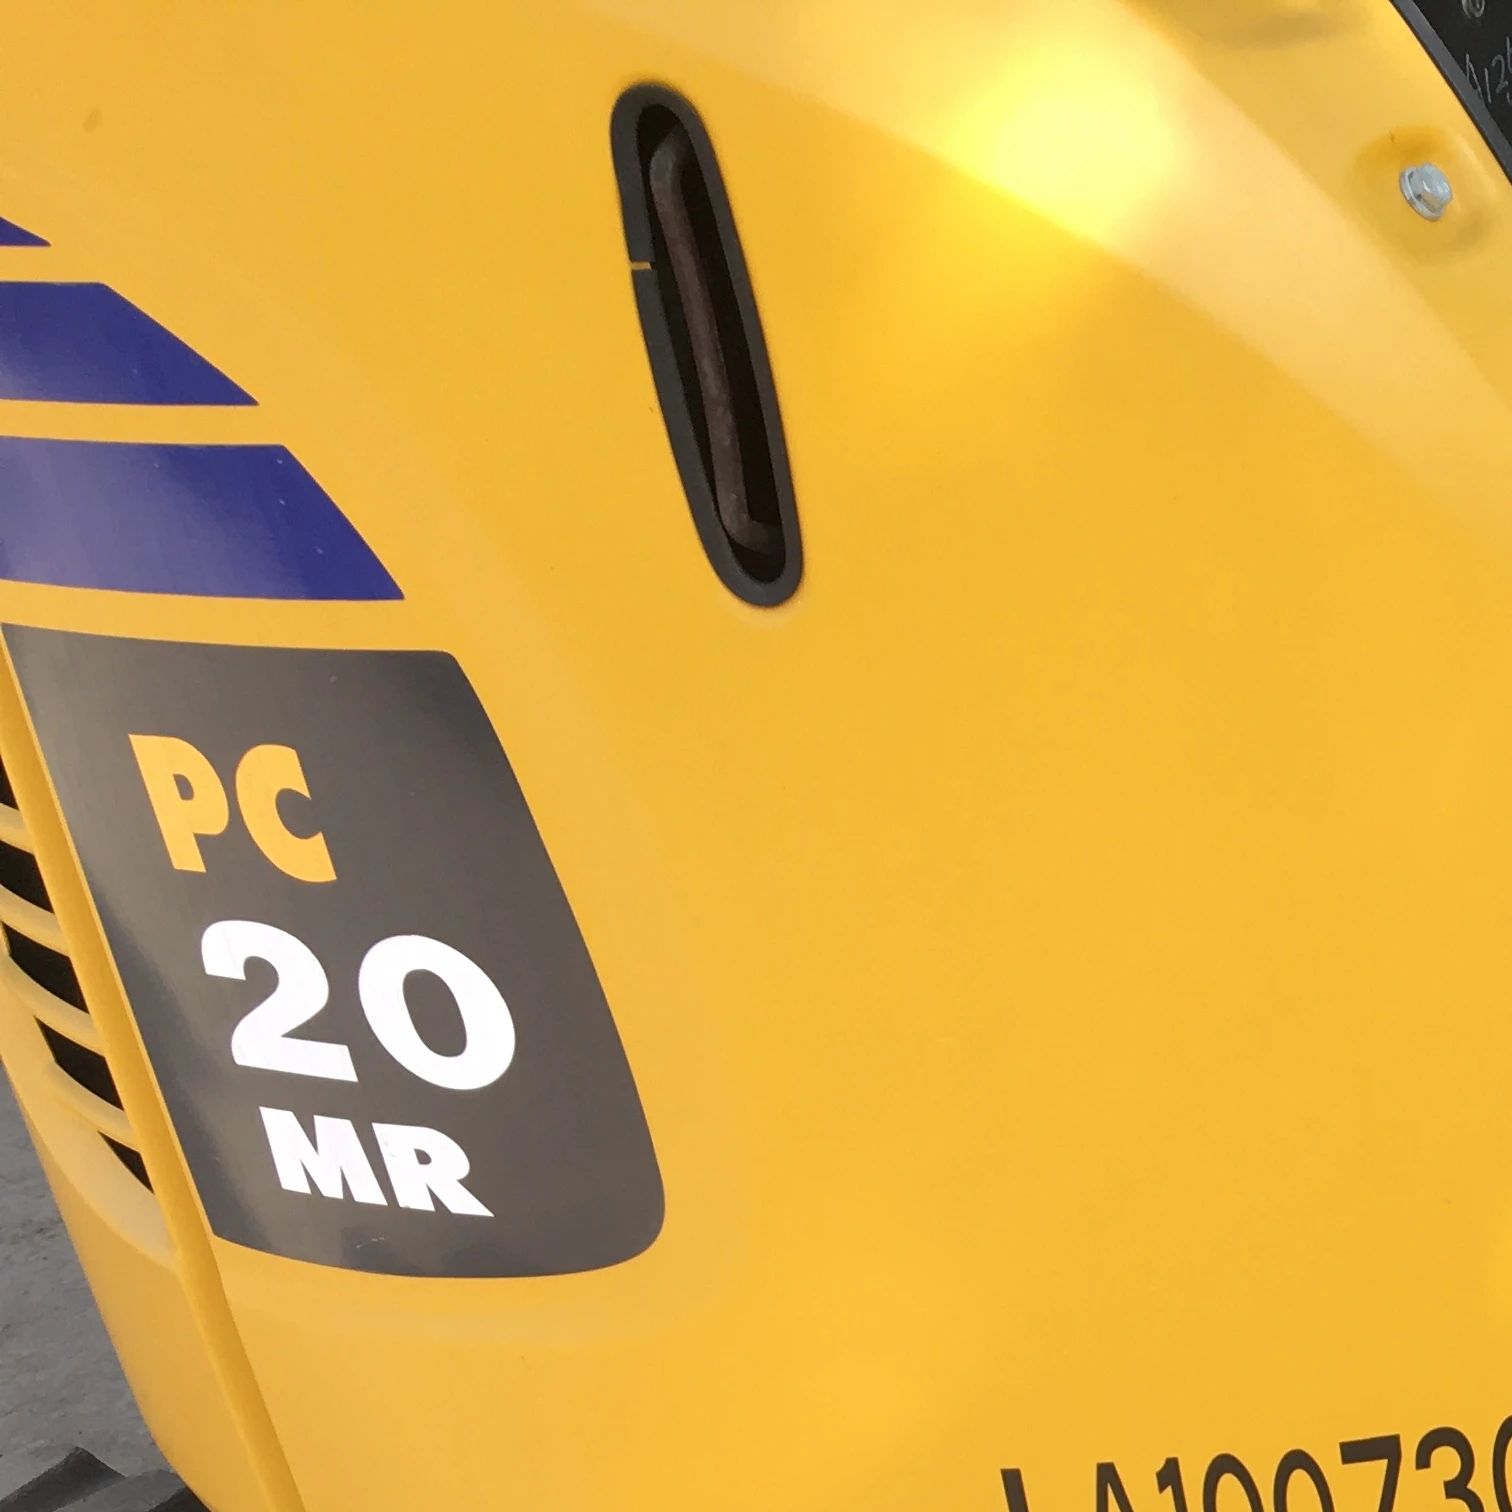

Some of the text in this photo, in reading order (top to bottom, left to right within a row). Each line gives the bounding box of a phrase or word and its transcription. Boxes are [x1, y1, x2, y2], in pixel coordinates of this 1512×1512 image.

[128, 734, 337, 882] PC
[201, 920, 516, 1091] 20
[259, 1106, 494, 1217] MR
